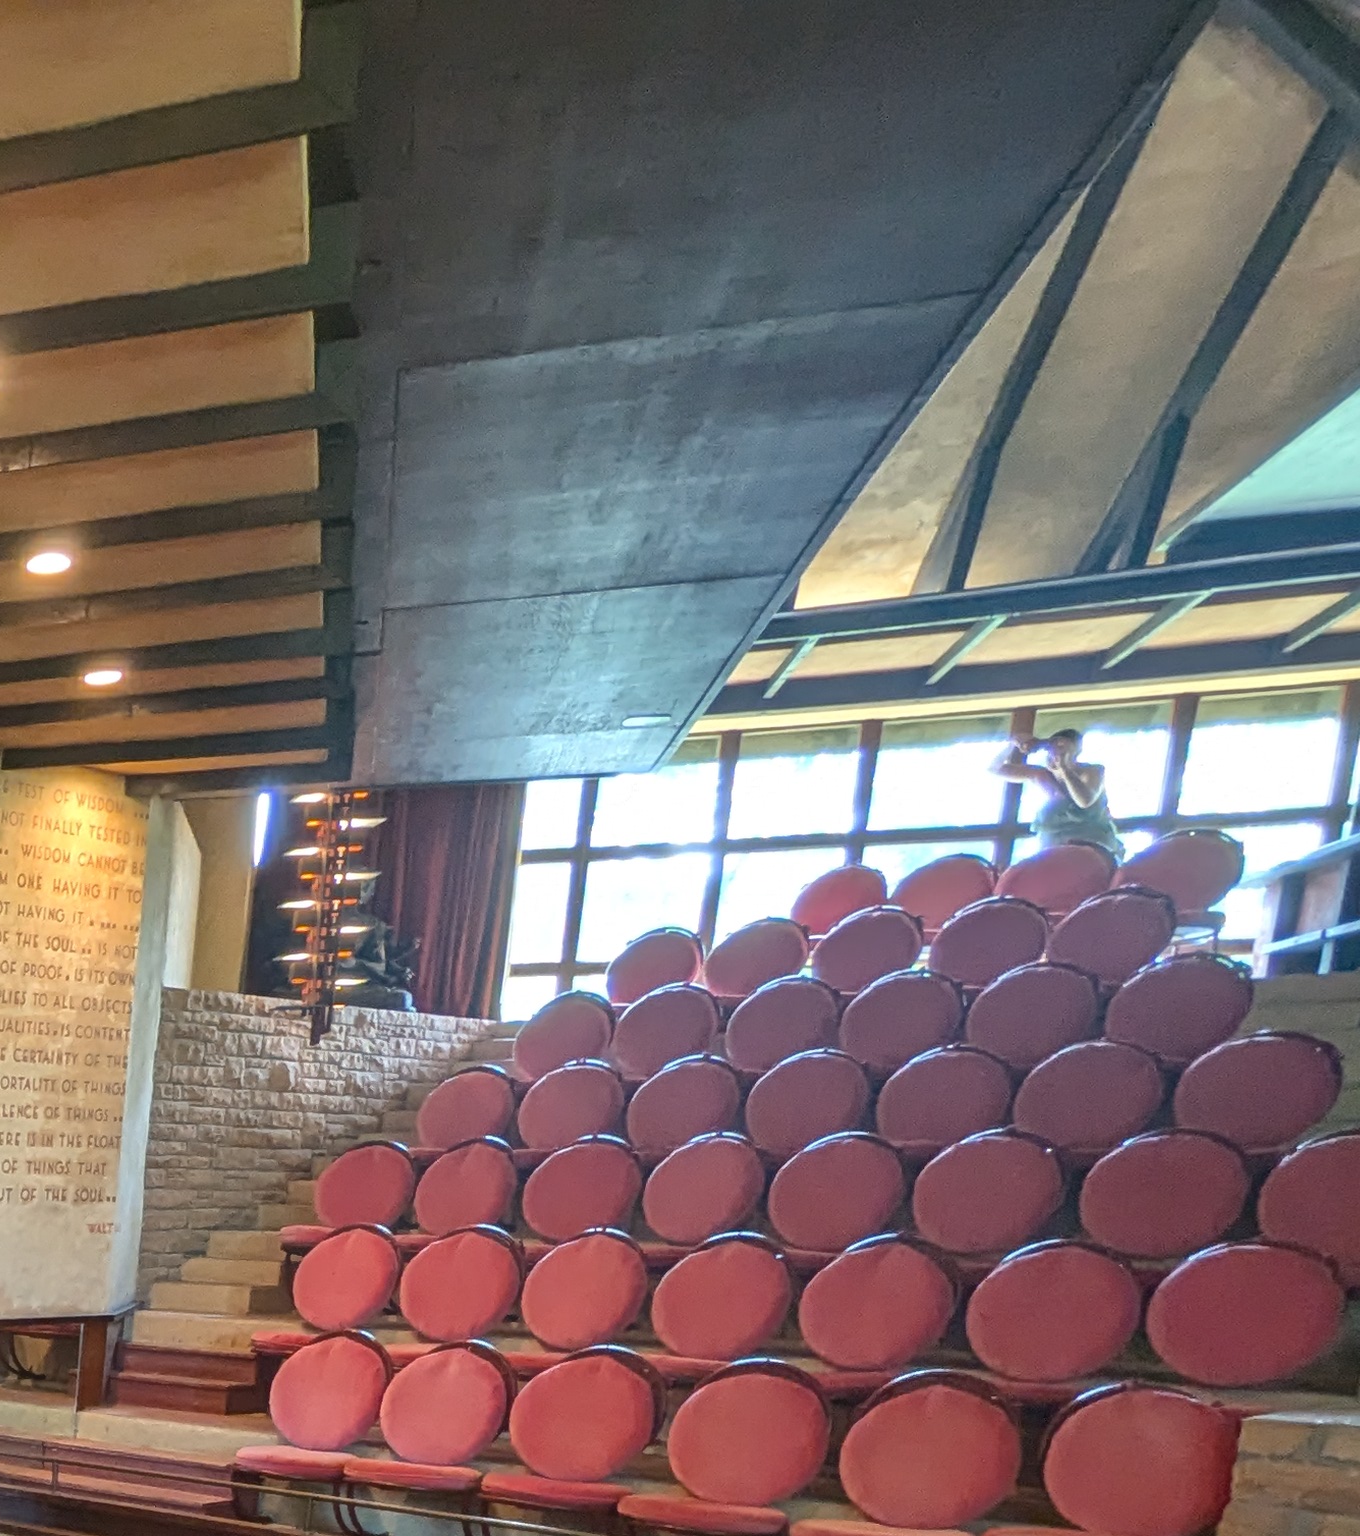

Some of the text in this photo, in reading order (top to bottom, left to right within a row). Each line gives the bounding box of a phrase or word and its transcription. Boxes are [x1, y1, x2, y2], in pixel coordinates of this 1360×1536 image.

[18, 782, 44, 799] TEST
[54, 789, 70, 803] OF
[76, 792, 124, 814] WISDOM
[0, 810, 25, 826] NOT
[32, 815, 82, 836] FINALLY
[89, 825, 131, 845] TESTED
[21, 844, 71, 864] WISDOM
[78, 852, 126, 875] CANNOT
[131, 861, 145, 875] BE
[17, 873, 42, 890] ONE
[53, 878, 100, 899] HAVING
[108, 887, 119, 900] IT
[127, 889, 142, 904] TO
[18, 903, 65, 922] HAVING
[73, 911, 84, 924] IT
[17, 932, 38, 948] THE
[45, 936, 76, 953] SOUL
[98, 942, 107, 956] IS
[115, 945, 138, 960] NOT
[0, 959, 16, 974] OF
[74, 968, 84, 982] IS
[89, 970, 105, 984] ITS
[108, 971, 135, 986] OWN
[33, 993, 47, 1007] TO
[53, 995, 75, 1010] ALL
[82, 997, 132, 1014] OBJECTS
[61, 1023, 70, 1037] IS
[75, 1025, 130, 1042] CONTENT
[13, 1048, 78, 1065] CERTAINTY
[84, 1053, 100, 1067] OF
[107, 1055, 128, 1069] THE
[61, 1079, 78, 1093] OF
[84, 1081, 126, 1096] THINGS
[43, 1106, 60, 1119] OF
[66, 1107, 108, 1122] THINGS
[27, 1132, 36, 1147] IS
[41, 1133, 54, 1147] IN
[60, 1133, 82, 1149] THE
[87, 1135, 122, 1150] FLOAT
[1, 1159, 18, 1174] OF
[26, 1160, 71, 1175] THINGS
[78, 1161, 107, 1176] THAT
[20, 1187, 37, 1201] OF
[44, 1188, 67, 1202] THE
